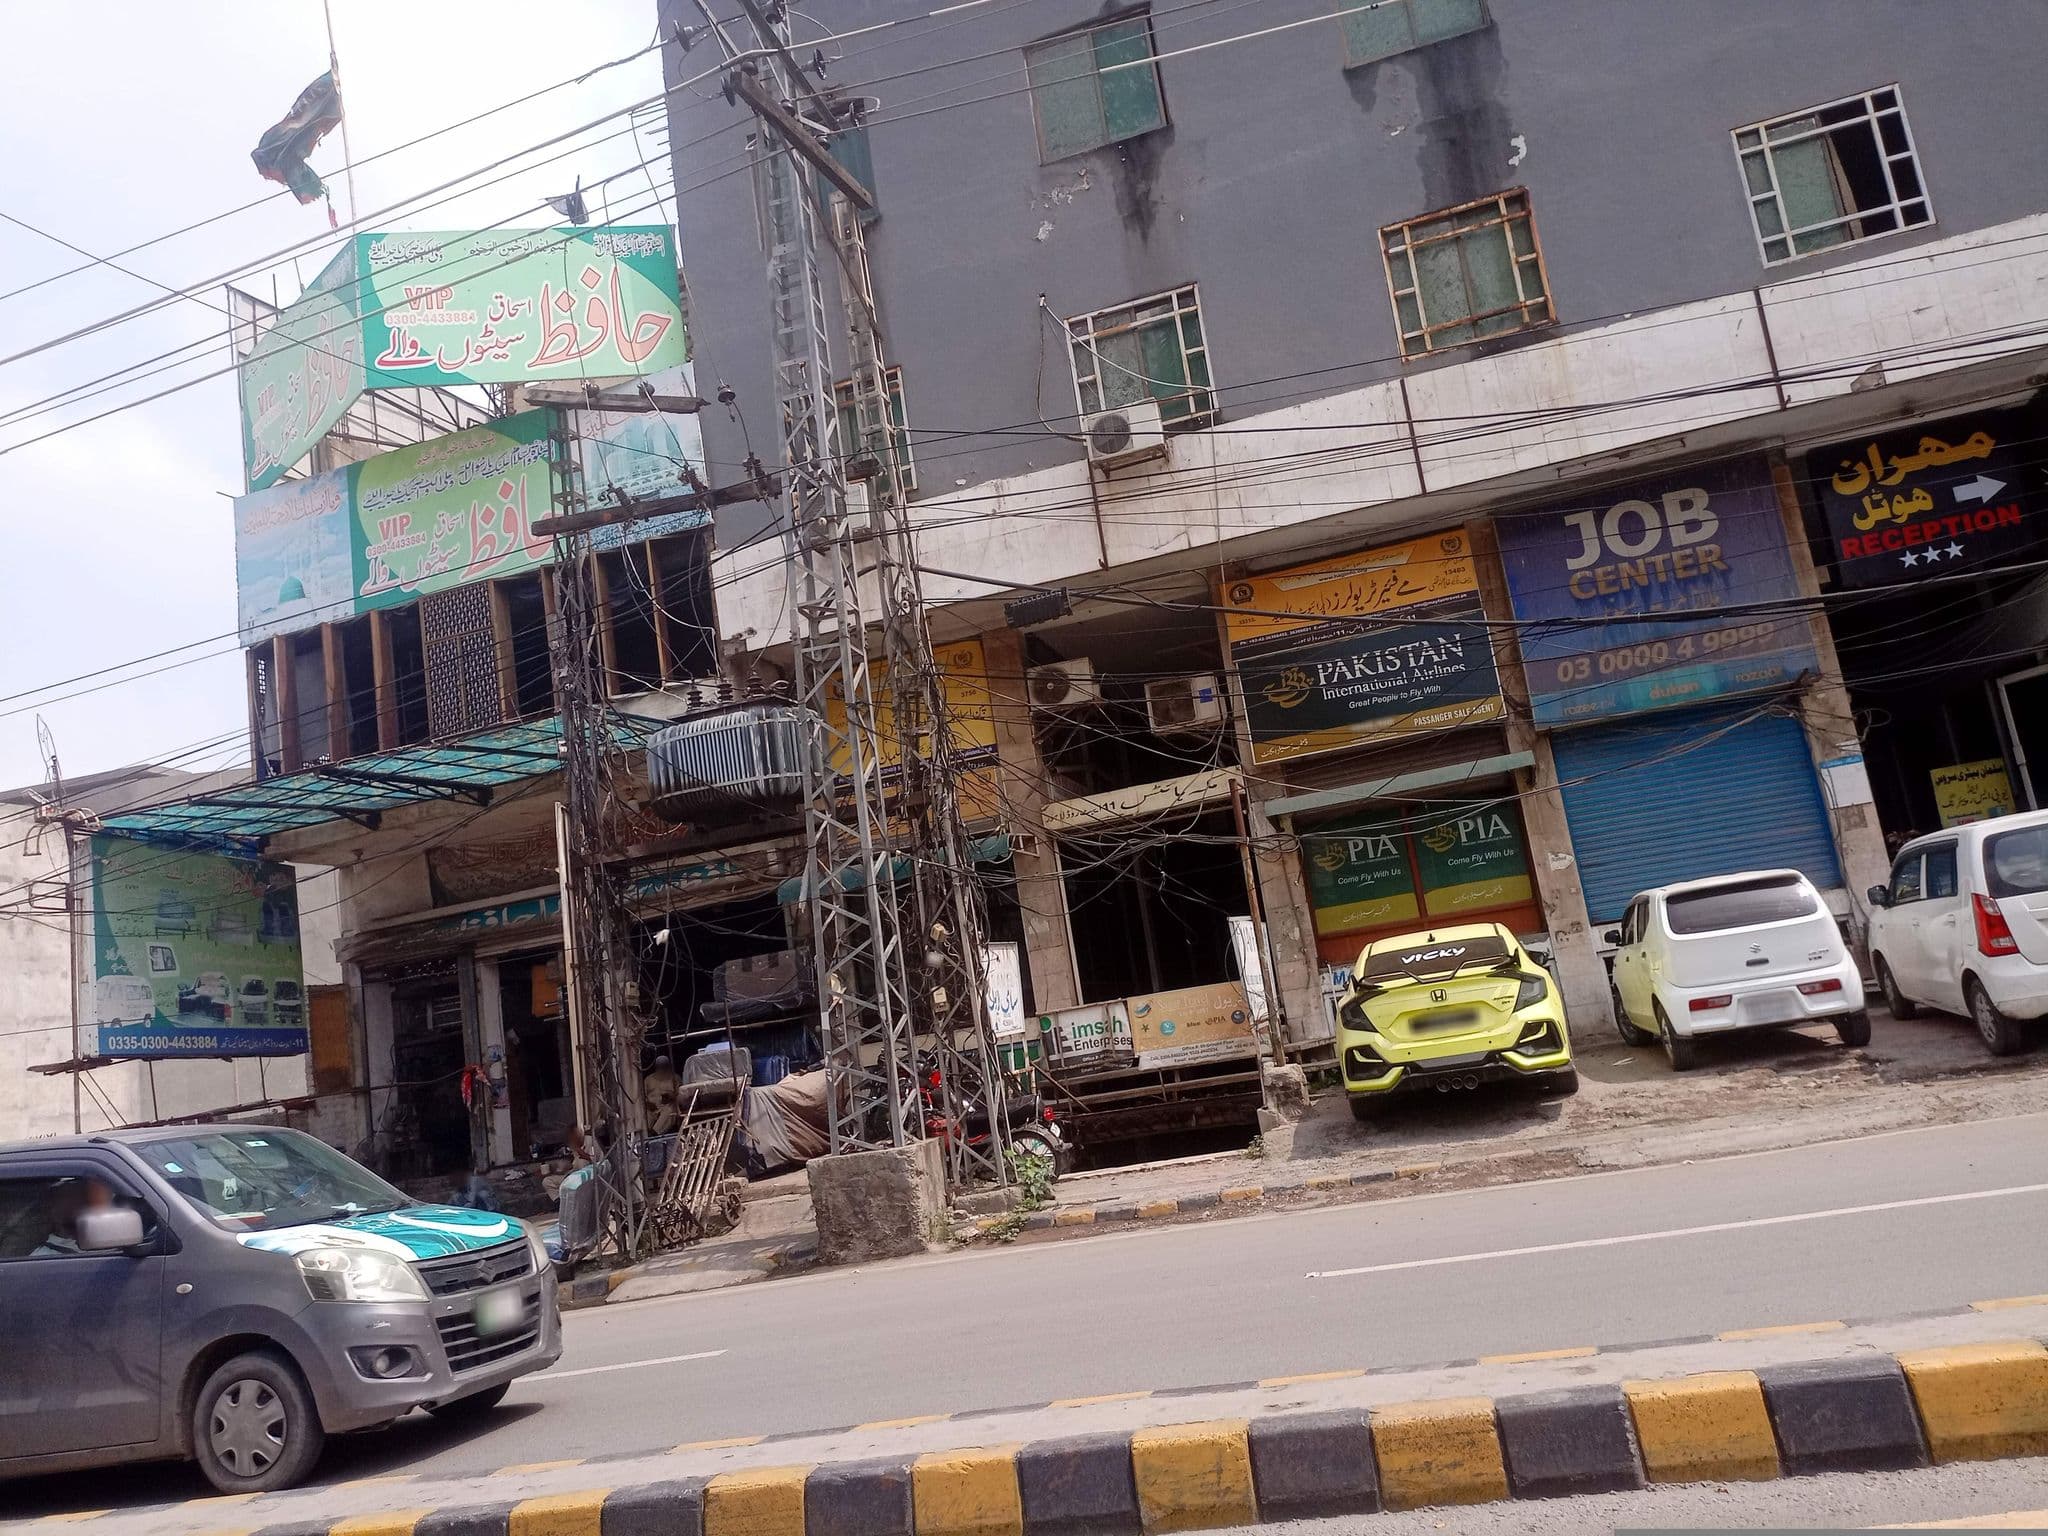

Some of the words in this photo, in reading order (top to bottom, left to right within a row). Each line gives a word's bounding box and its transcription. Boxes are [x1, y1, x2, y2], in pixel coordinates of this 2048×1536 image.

[404, 286, 453, 310] VIP
[528, 266, 672, 368] حافظ
[375, 327, 436, 369] والے
[378, 514, 412, 541] VIP
[1564, 487, 1720, 571] JOB
[1839, 503, 2022, 561] RECEPTION
[1568, 543, 1729, 600] CENTER
[1316, 632, 1465, 686] PAKISTAN
[1556, 656, 1592, 682] 03
[1599, 640, 1669, 675] 0000
[1676, 635, 1696, 659] 4
[1322, 671, 1408, 701] International
[1411, 661, 1467, 683] Airlines
[1348, 698, 1371, 710] Great
[1371, 693, 1400, 708] People
[1400, 691, 1408, 700] to
[1409, 688, 1423, 701] Fly
[1423, 684, 1442, 697] With
[1413, 710, 1453, 727] PASSANGER
[1457, 814, 1512, 843] PIA
[1348, 834, 1399, 862] PIA
[1471, 853, 1483, 862] Fly
[1485, 850, 1502, 860] With
[1503, 848, 1515, 857] Us
[1360, 873, 1372, 881] Fly
[1373, 870, 1390, 879] With
[1391, 867, 1402, 876] Us
[1401, 946, 1466, 965] VICKY
